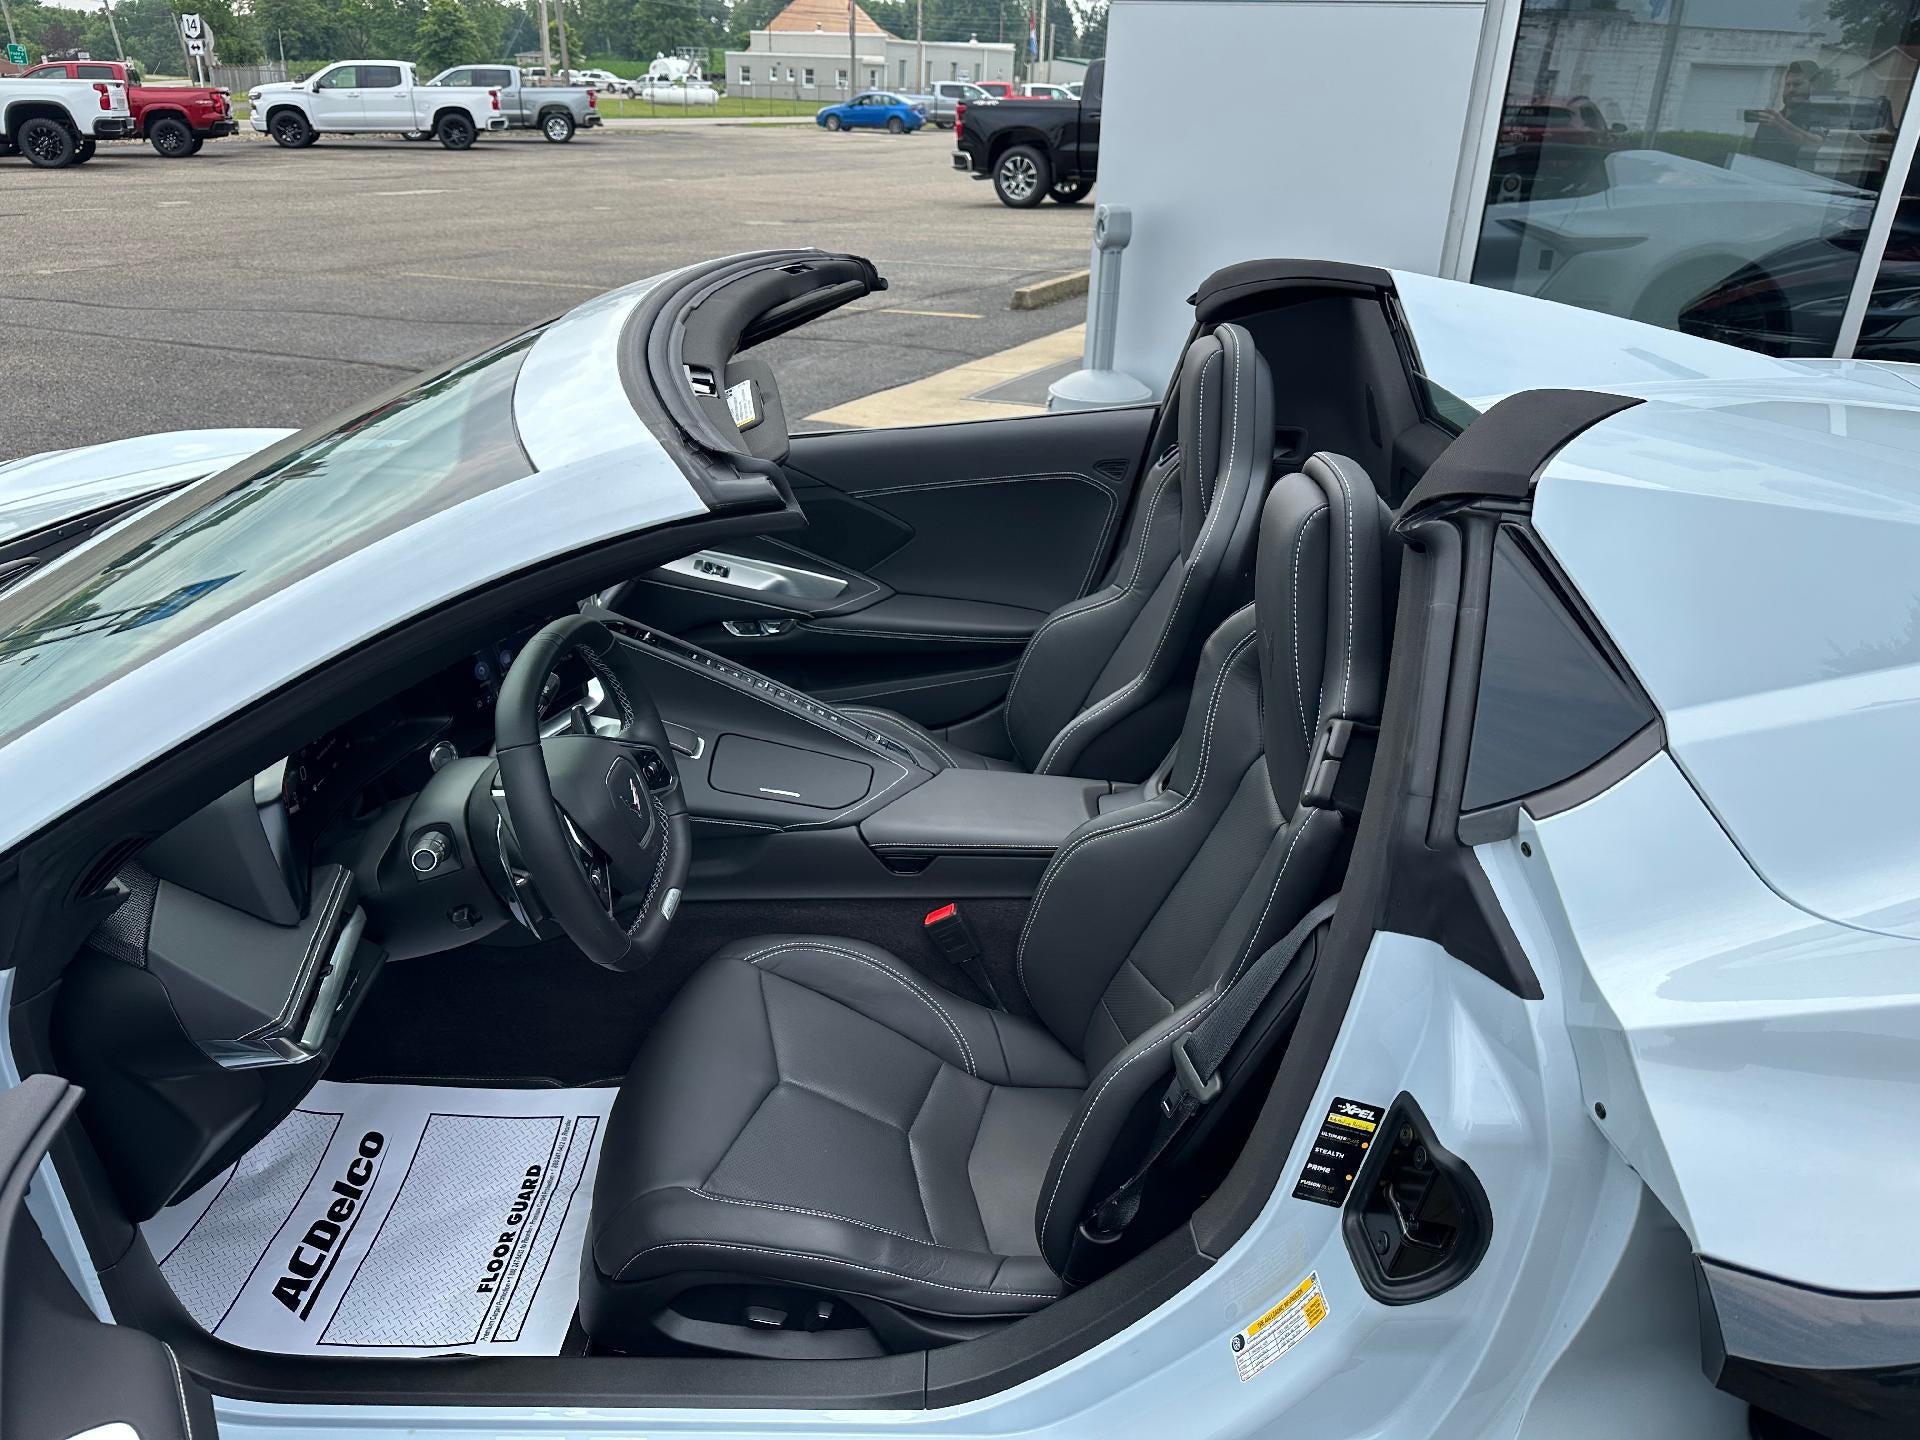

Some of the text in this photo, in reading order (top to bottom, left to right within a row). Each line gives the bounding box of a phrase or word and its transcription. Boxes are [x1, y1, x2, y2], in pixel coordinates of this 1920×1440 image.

[186, 18, 197, 31] 14
[1340, 1102, 1375, 1120] XPEL
[1314, 1146, 1345, 1159] STEALTH
[1307, 1162, 1331, 1174] PRIME
[272, 1131, 384, 1313] ACDelco
[477, 1164, 541, 1293] FLOOR GUARD
